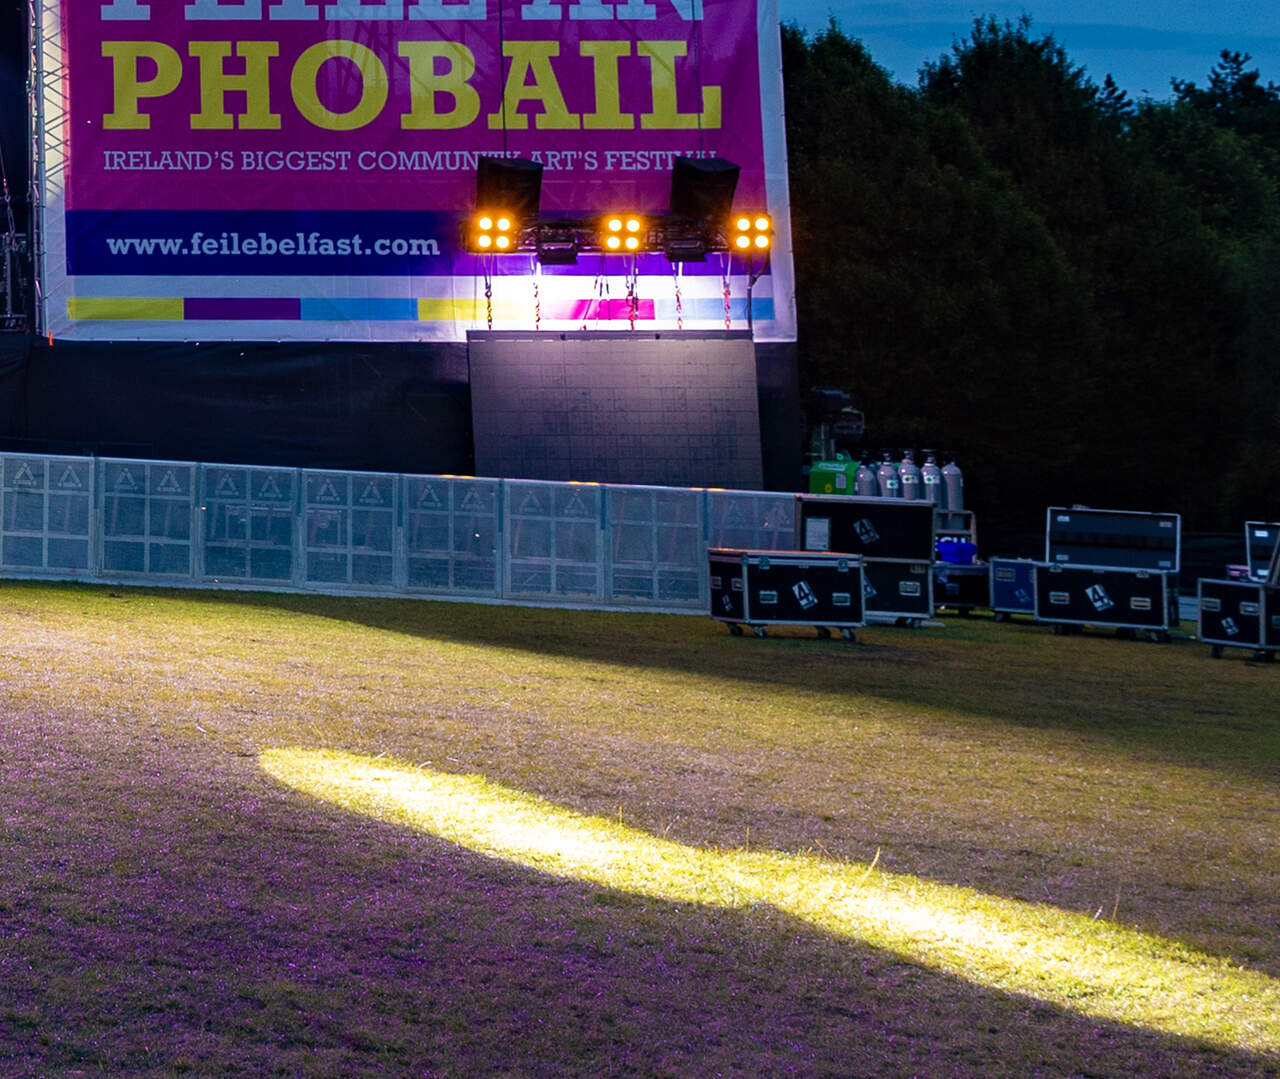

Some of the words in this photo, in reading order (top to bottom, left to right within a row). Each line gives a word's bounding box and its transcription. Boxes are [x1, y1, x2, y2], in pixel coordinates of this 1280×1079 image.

[101, 39, 723, 131] PHOBAIL
[103, 151, 235, 171] IRELAND'S
[241, 151, 351, 171] BIGGEST
[603, 151, 717, 171] FESTI
[106, 232, 441, 256] www.feilebelfast.com
